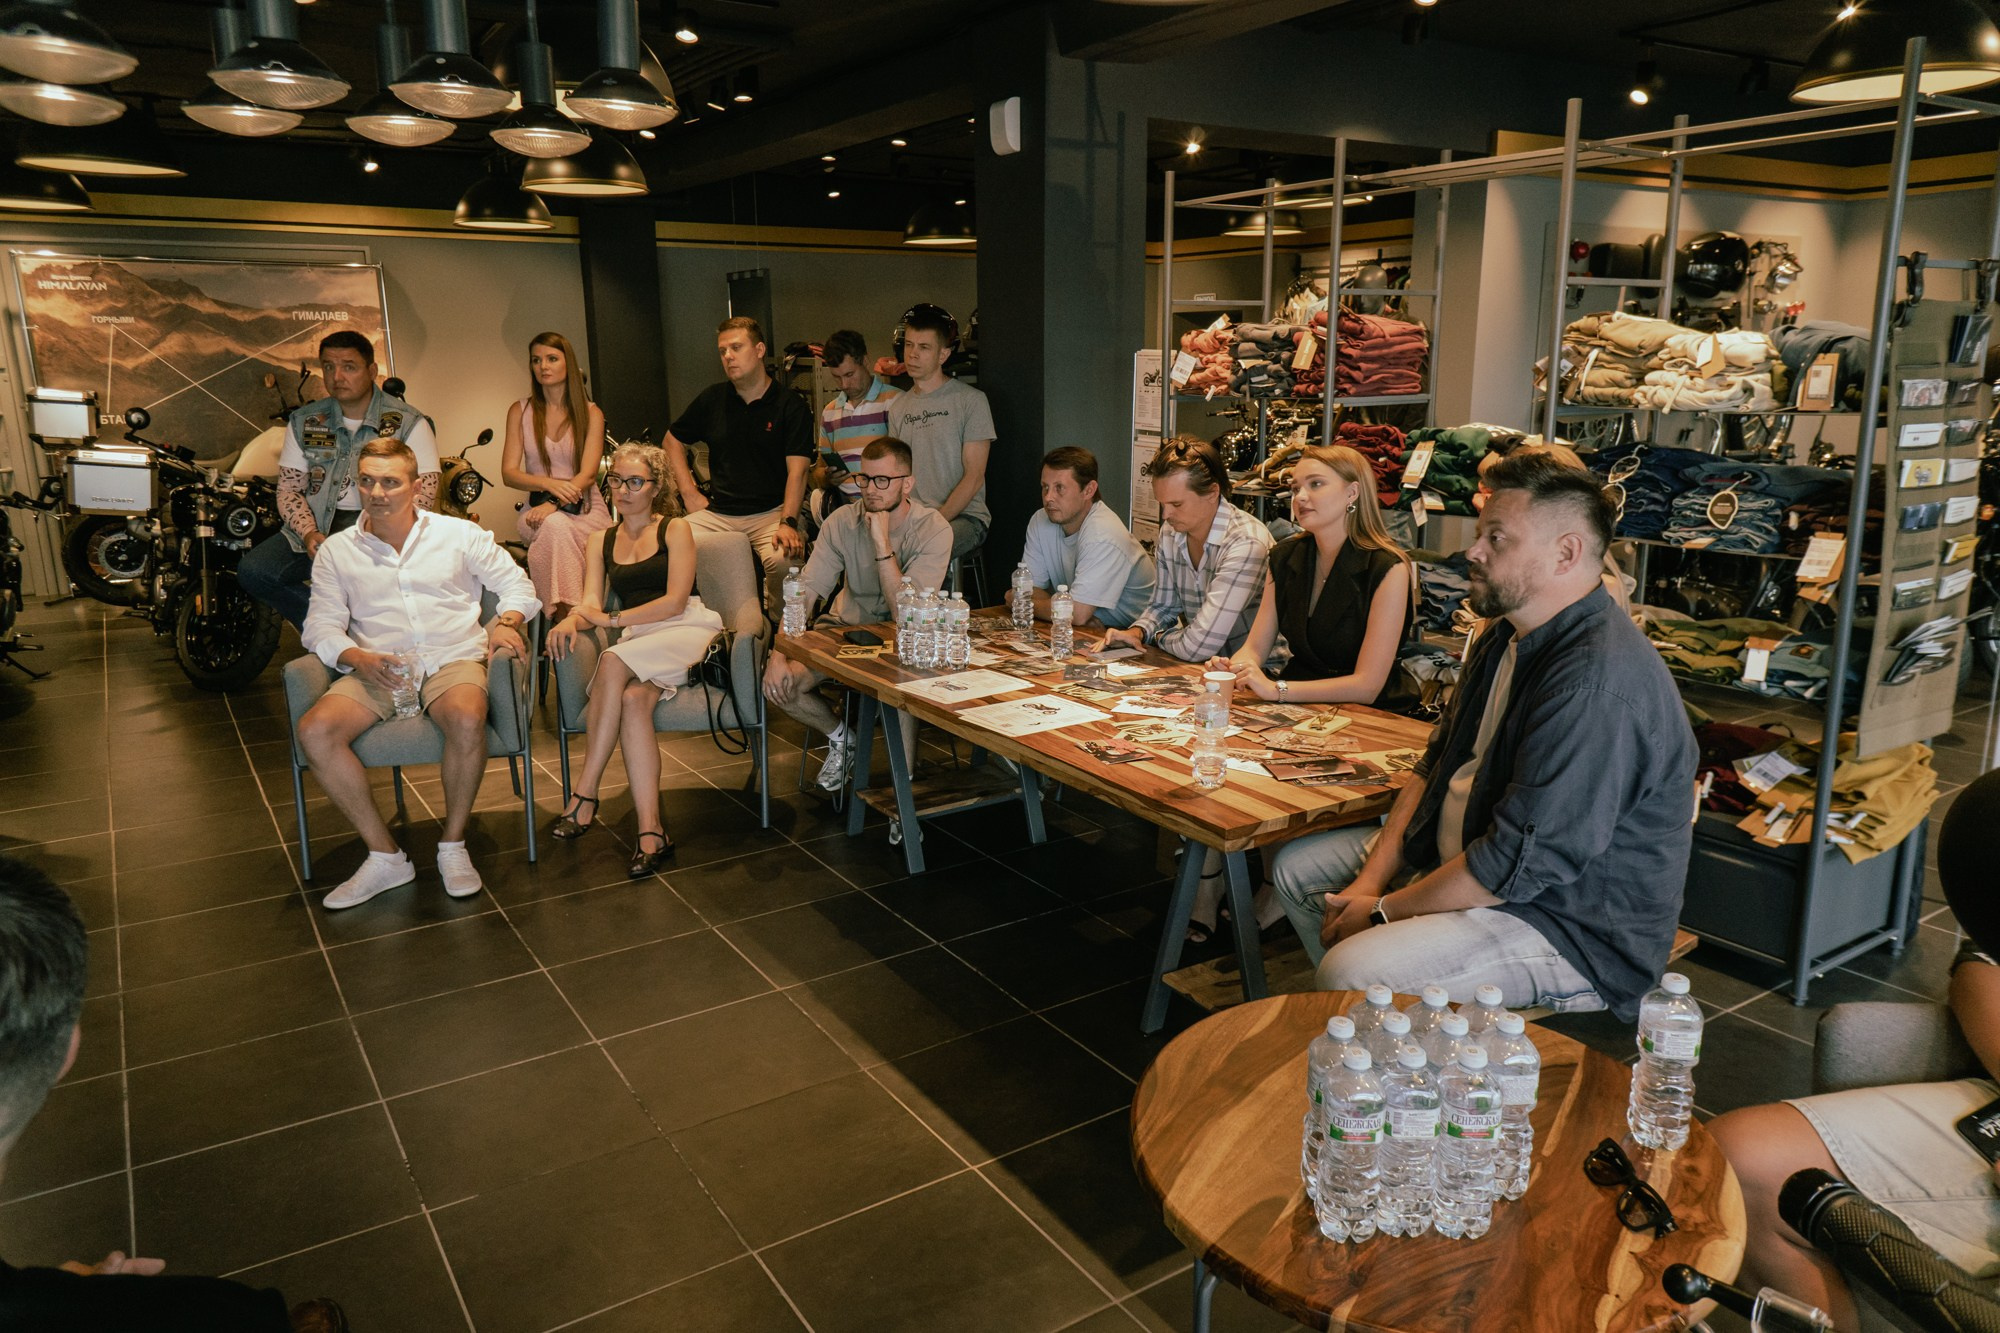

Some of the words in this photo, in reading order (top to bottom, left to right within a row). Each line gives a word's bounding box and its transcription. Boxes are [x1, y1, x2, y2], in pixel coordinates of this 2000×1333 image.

[37, 280, 107, 291] HIMALAYAN
[91, 315, 135, 324] ГОРНЫМИ
[292, 310, 349, 321] ГИМАЛАЕВ
[922, 409, 949, 424] Jeans
